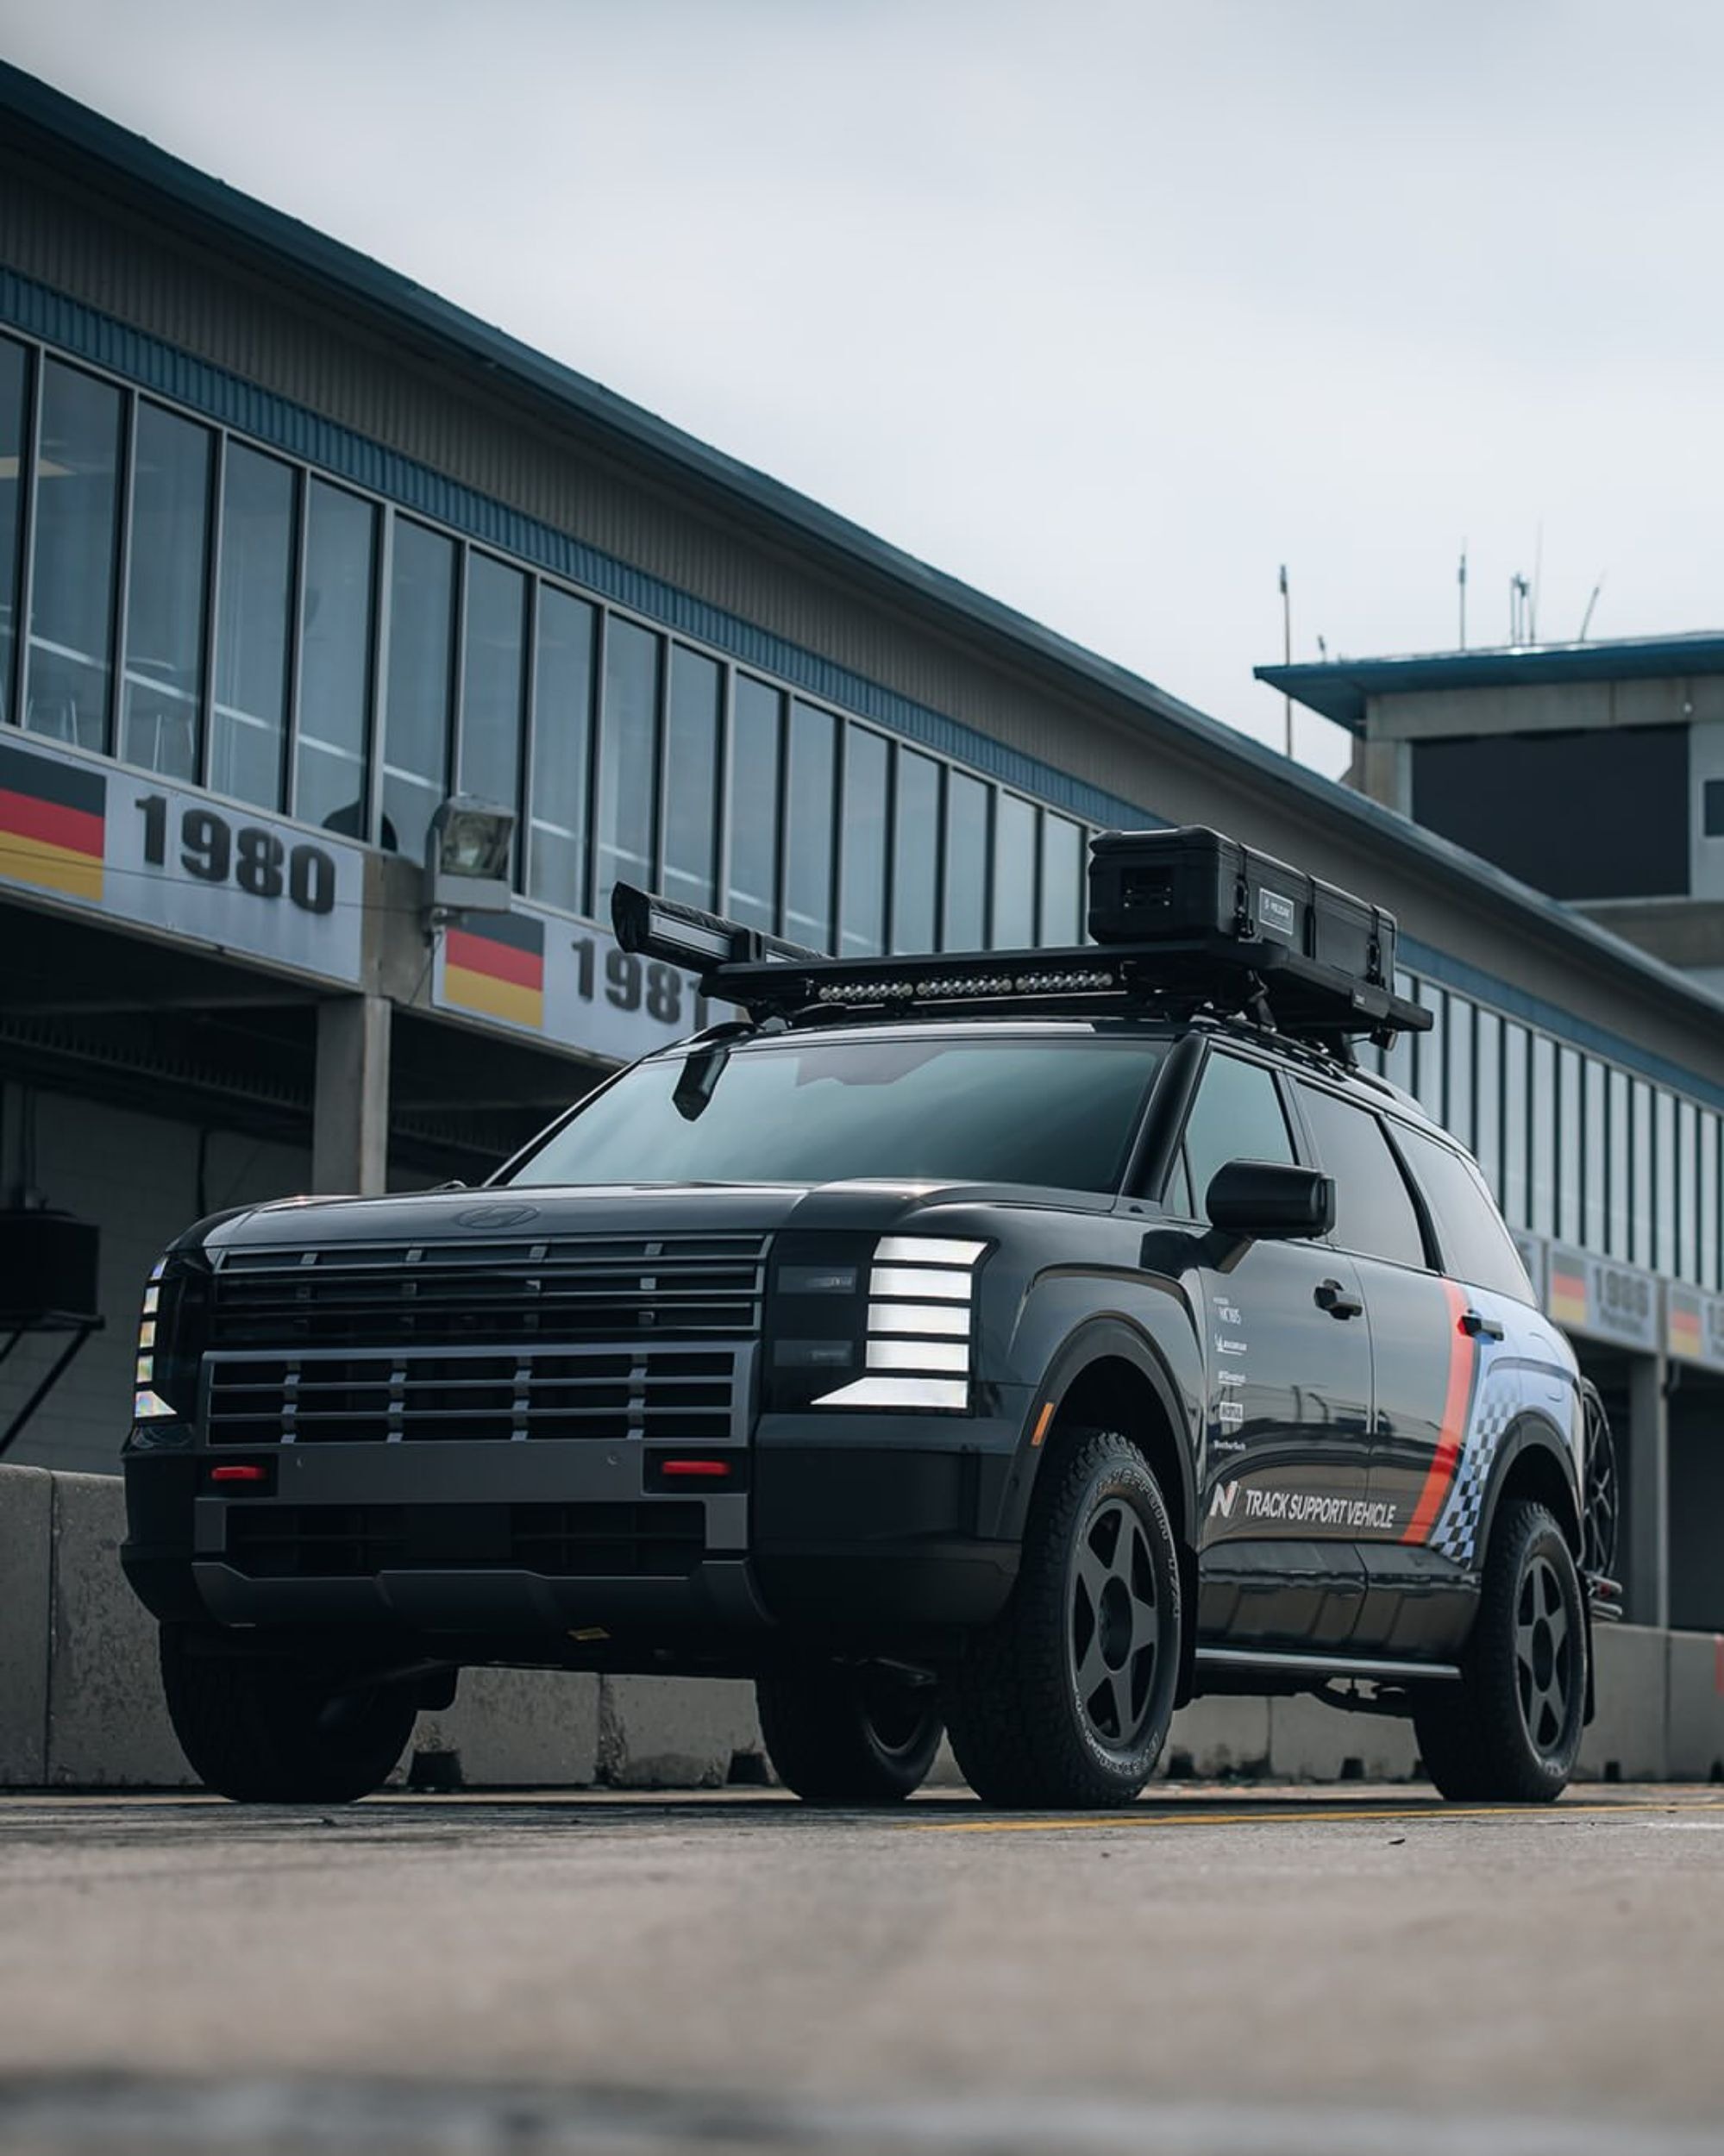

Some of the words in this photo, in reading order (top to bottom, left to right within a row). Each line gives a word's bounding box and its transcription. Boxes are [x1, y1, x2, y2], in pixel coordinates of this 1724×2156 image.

[135, 794, 335, 915] 1980
[572, 937, 708, 1033] 1981
[1245, 1489, 1291, 1518] TRACK
[1288, 1494, 1348, 1525] SUPPORT
[1346, 1500, 1397, 1528] VEHICLE
